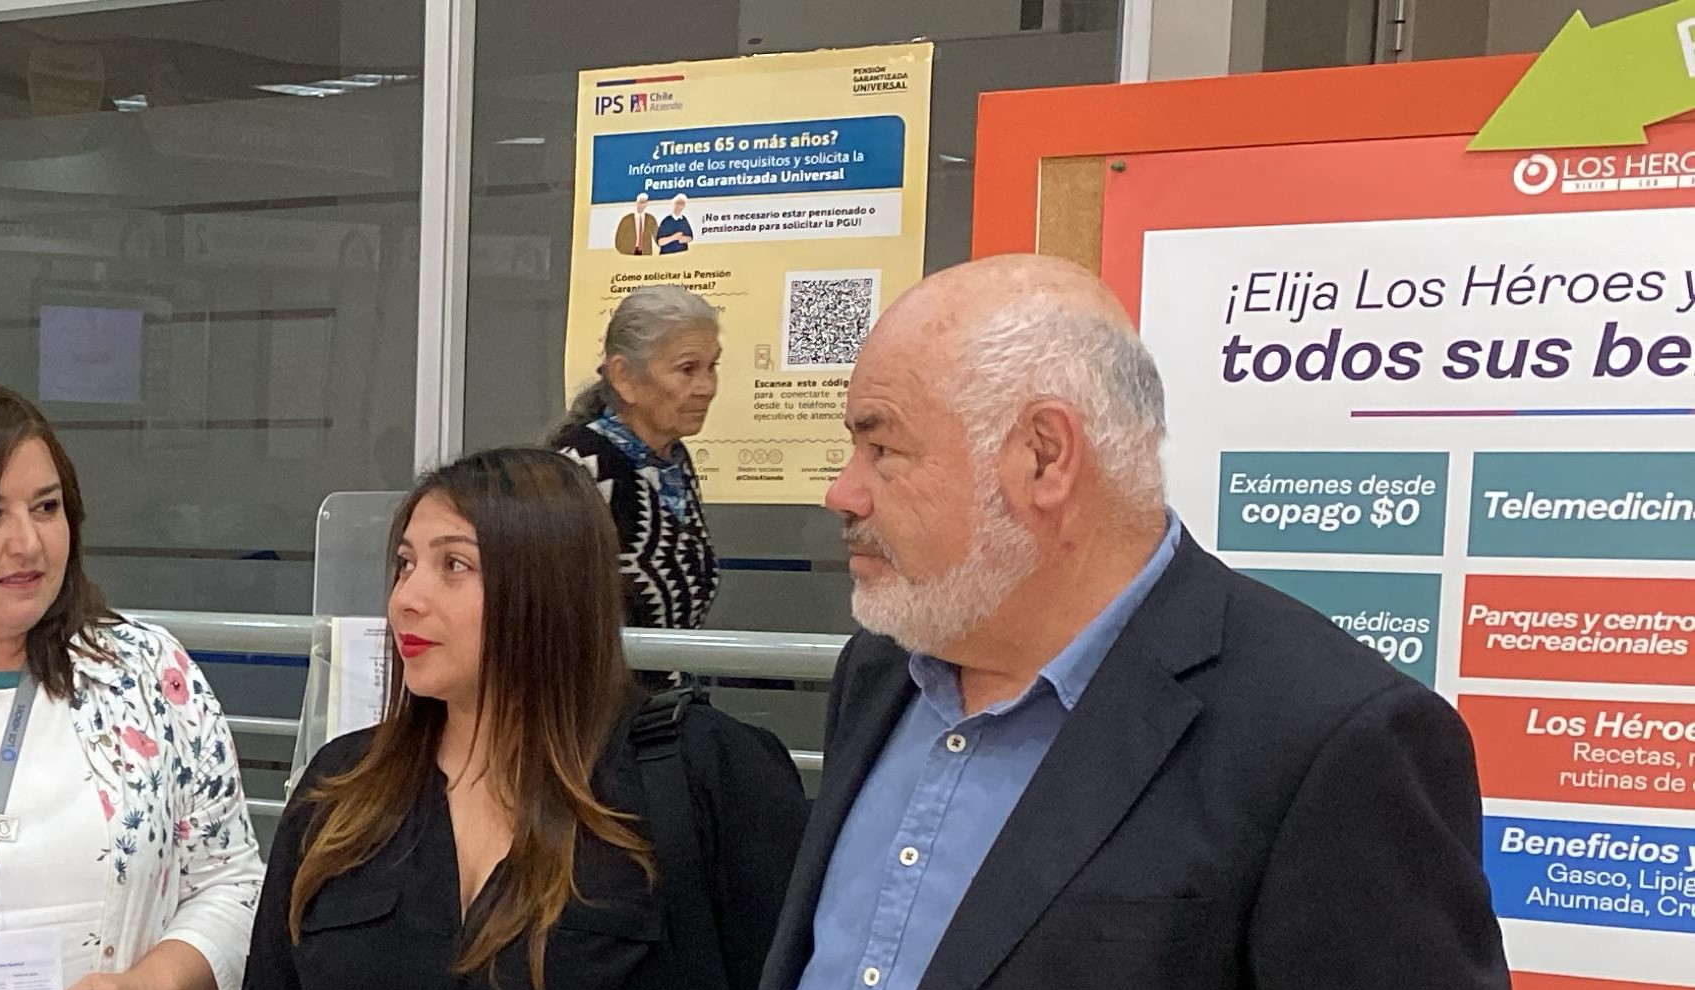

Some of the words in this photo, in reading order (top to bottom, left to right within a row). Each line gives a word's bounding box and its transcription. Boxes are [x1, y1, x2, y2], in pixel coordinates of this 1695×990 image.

[649, 91, 673, 102] Chile
[853, 81, 908, 92] UNIVERSAL
[595, 95, 625, 116] IPS
[652, 140, 711, 160] ¿Tienes
[714, 136, 735, 152] 65
[738, 139, 750, 151] o
[753, 133, 788, 150] más
[790, 129, 839, 148] años?
[628, 161, 686, 176] Infórmate
[689, 160, 705, 172] de
[707, 158, 726, 171] los
[729, 156, 791, 172] requisitos
[793, 156, 803, 169] y
[805, 151, 850, 165] solicita
[853, 150, 865, 162] la
[1563, 156, 1617, 179] LOS
[644, 176, 694, 191] Pensión
[696, 171, 778, 188] Garantizada
[781, 167, 845, 183] Universal
[721, 213, 731, 221] es
[733, 210, 779, 221] necesario
[782, 209, 806, 219] estar
[809, 206, 867, 219] pensionado
[869, 207, 876, 215] o
[701, 223, 757, 235] pensionada
[759, 223, 781, 232] para
[782, 219, 823, 230] solicitar
[825, 219, 834, 228] la
[610, 272, 642, 285] ¿Cómo
[644, 270, 682, 281] solicitar
[683, 270, 692, 280] la
[694, 269, 732, 279] Pensión
[1225, 269, 1339, 325] ¡Elija
[1355, 268, 1446, 310] Los
[1461, 263, 1667, 308] Héroes
[1221, 328, 1424, 383] todos
[1442, 334, 1573, 381] sus
[1593, 321, 1695, 380] be
[754, 379, 793, 389] Escanea
[797, 379, 817, 388] este
[754, 391, 774, 400] para
[754, 401, 780, 410] desde
[784, 401, 794, 409] tu
[798, 400, 837, 409] teléfono
[754, 413, 795, 422] ejecutivo
[796, 412, 808, 420] de
[1229, 473, 1353, 496] Exámenes
[1358, 473, 1437, 496] desde
[1241, 501, 1362, 532] copago
[1370, 495, 1421, 528] $0
[1484, 490, 1695, 521] Telemedicin
[1331, 610, 1430, 634] médicas
[1467, 604, 1578, 634] Parques
[1581, 612, 1602, 635] y
[1486, 630, 1689, 656] recreacionales
[1526, 708, 1587, 737] Los
[1573, 742, 1682, 770] Recetas,
[1559, 768, 1648, 792] rutinas
[1653, 771, 1686, 793] de
[1501, 826, 1680, 864] Beneficios
[1547, 862, 1633, 891] Gasco,
[1525, 885, 1651, 918] Ahumada,
